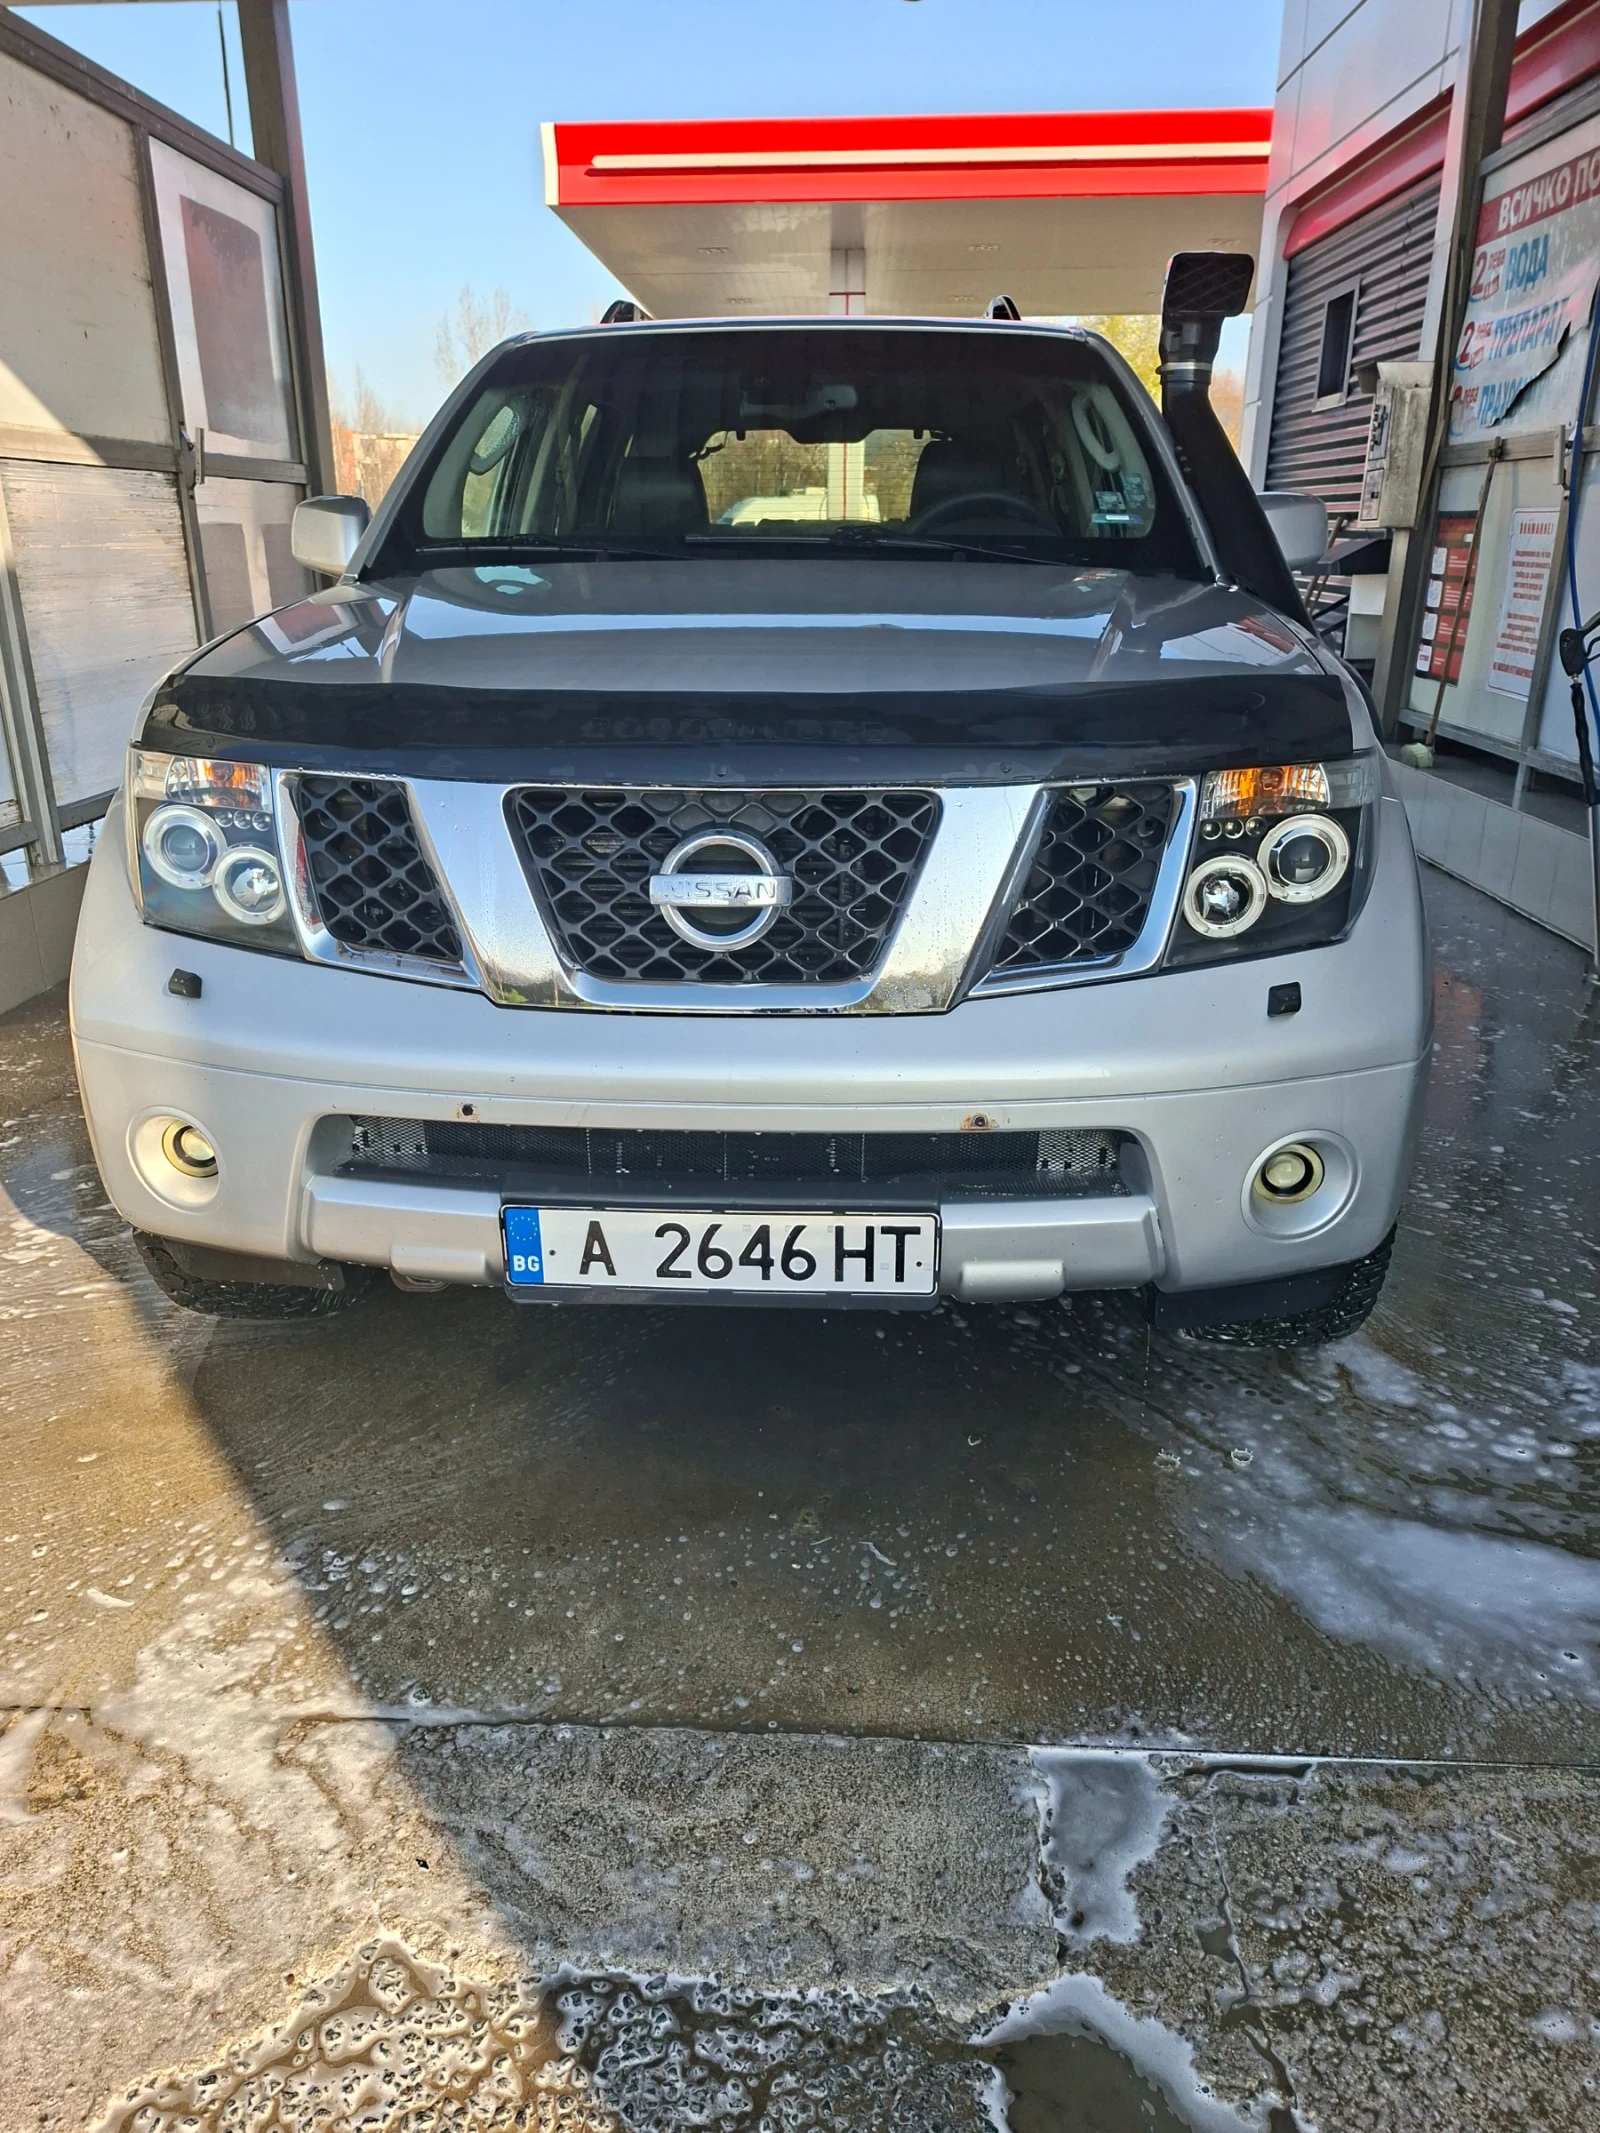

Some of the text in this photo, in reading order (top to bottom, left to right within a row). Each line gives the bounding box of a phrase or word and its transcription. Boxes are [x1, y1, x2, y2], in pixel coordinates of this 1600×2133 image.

[1498, 166, 1572, 232] ВСИЧКО
[1471, 250, 1488, 296] 2
[1504, 233, 1550, 293] ВОДА
[1458, 320, 1476, 364] 2
[1487, 296, 1570, 361] ПРЕПАРАТ
[664, 880, 777, 900] NISSAN
[513, 1255, 540, 1272] BG
[579, 1220, 922, 1283] A 2646 HT
